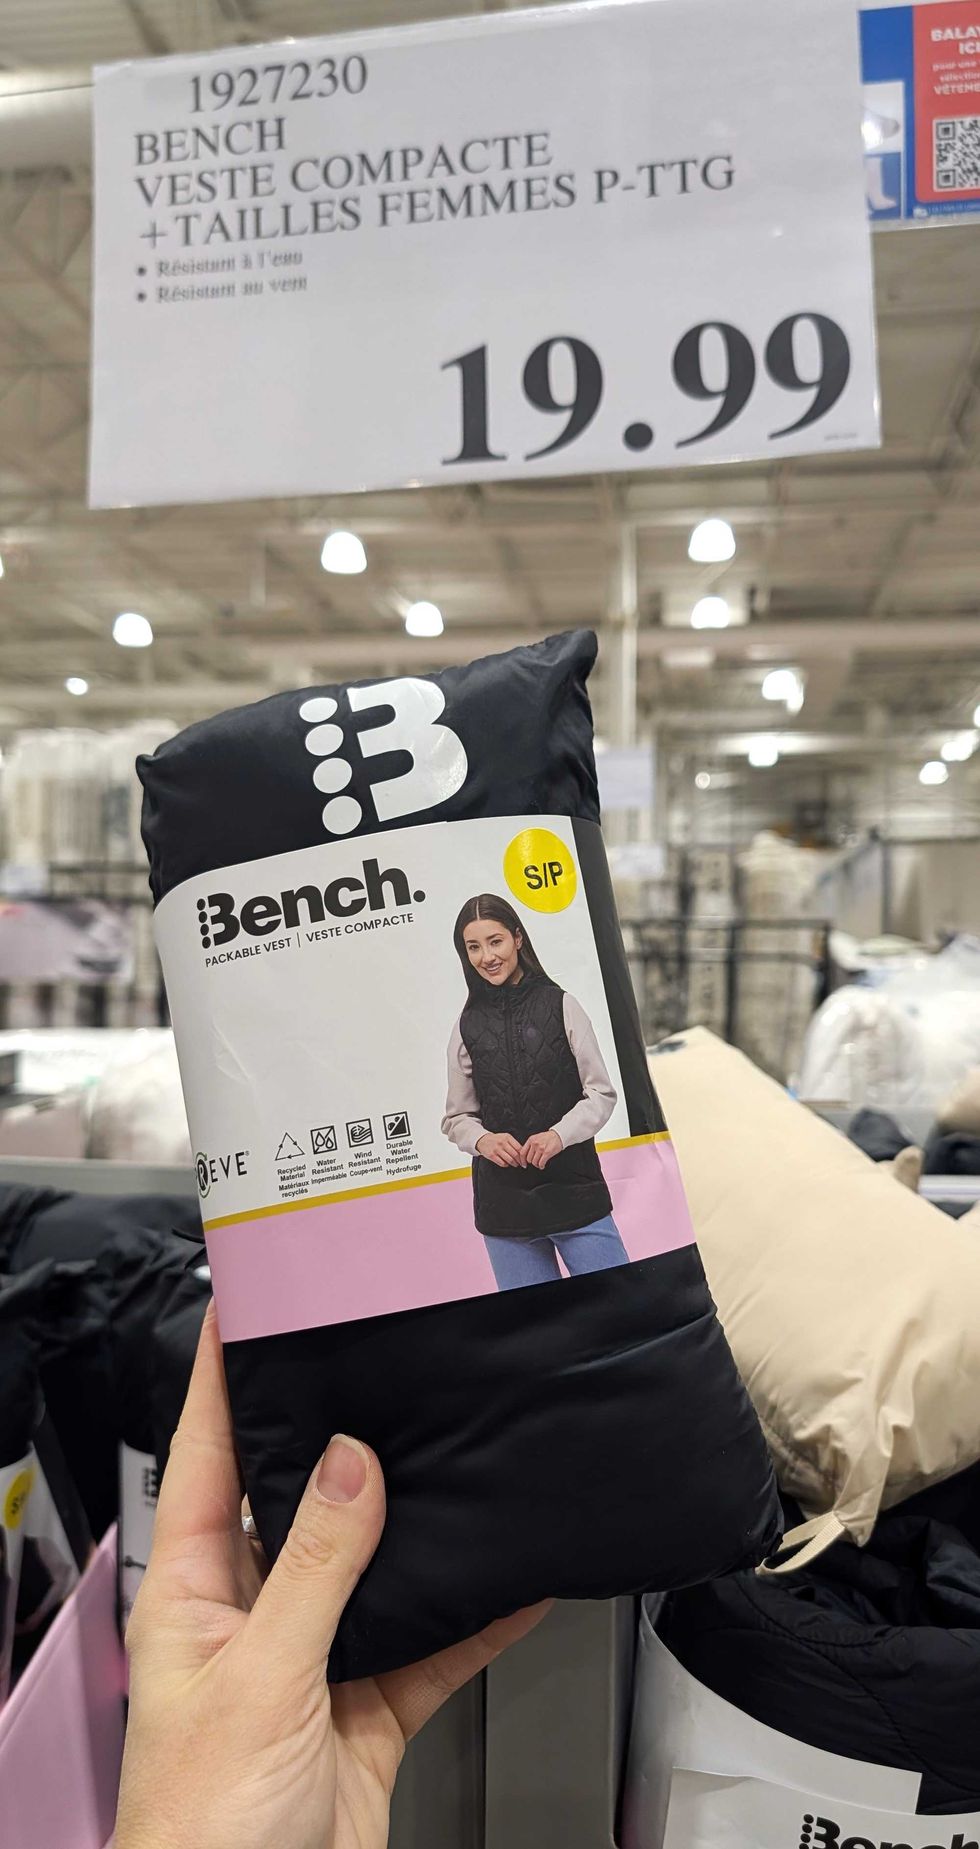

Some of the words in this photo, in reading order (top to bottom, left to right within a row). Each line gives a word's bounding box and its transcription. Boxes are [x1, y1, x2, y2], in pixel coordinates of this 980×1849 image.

[189, 55, 368, 113] 1927230
[134, 117, 286, 166] BENCH
[134, 163, 276, 208] VESTE
[290, 132, 552, 192] COMPACTE
[377, 172, 577, 228] FEMMES
[594, 154, 735, 205] P-TTG
[441, 311, 851, 466] 19.99
[523, 860, 563, 890] S/P
[205, 945, 262, 968] PACKABLE
[263, 937, 292, 953] VEST
[305, 926, 342, 942] VESTE
[344, 912, 415, 934] COMPACTE
[386, 1139, 413, 1150] Durable
[354, 1150, 373, 1160] Wind
[390, 1147, 411, 1156] Water
[316, 1157, 337, 1167] Water
[348, 1156, 381, 1168] Resistant
[385, 1153, 419, 1165] Repellent
[277, 1164, 307, 1176] Recycled
[311, 1163, 344, 1175] Resistant
[349, 1165, 383, 1177] Coupe-vent
[386, 1163, 422, 1176] Hydrofuge
[280, 1171, 306, 1182] Material
[311, 1172, 347, 1185] Imperméable
[278, 1179, 310, 1191] Matériaux
[281, 1188, 309, 1198] recyclés
